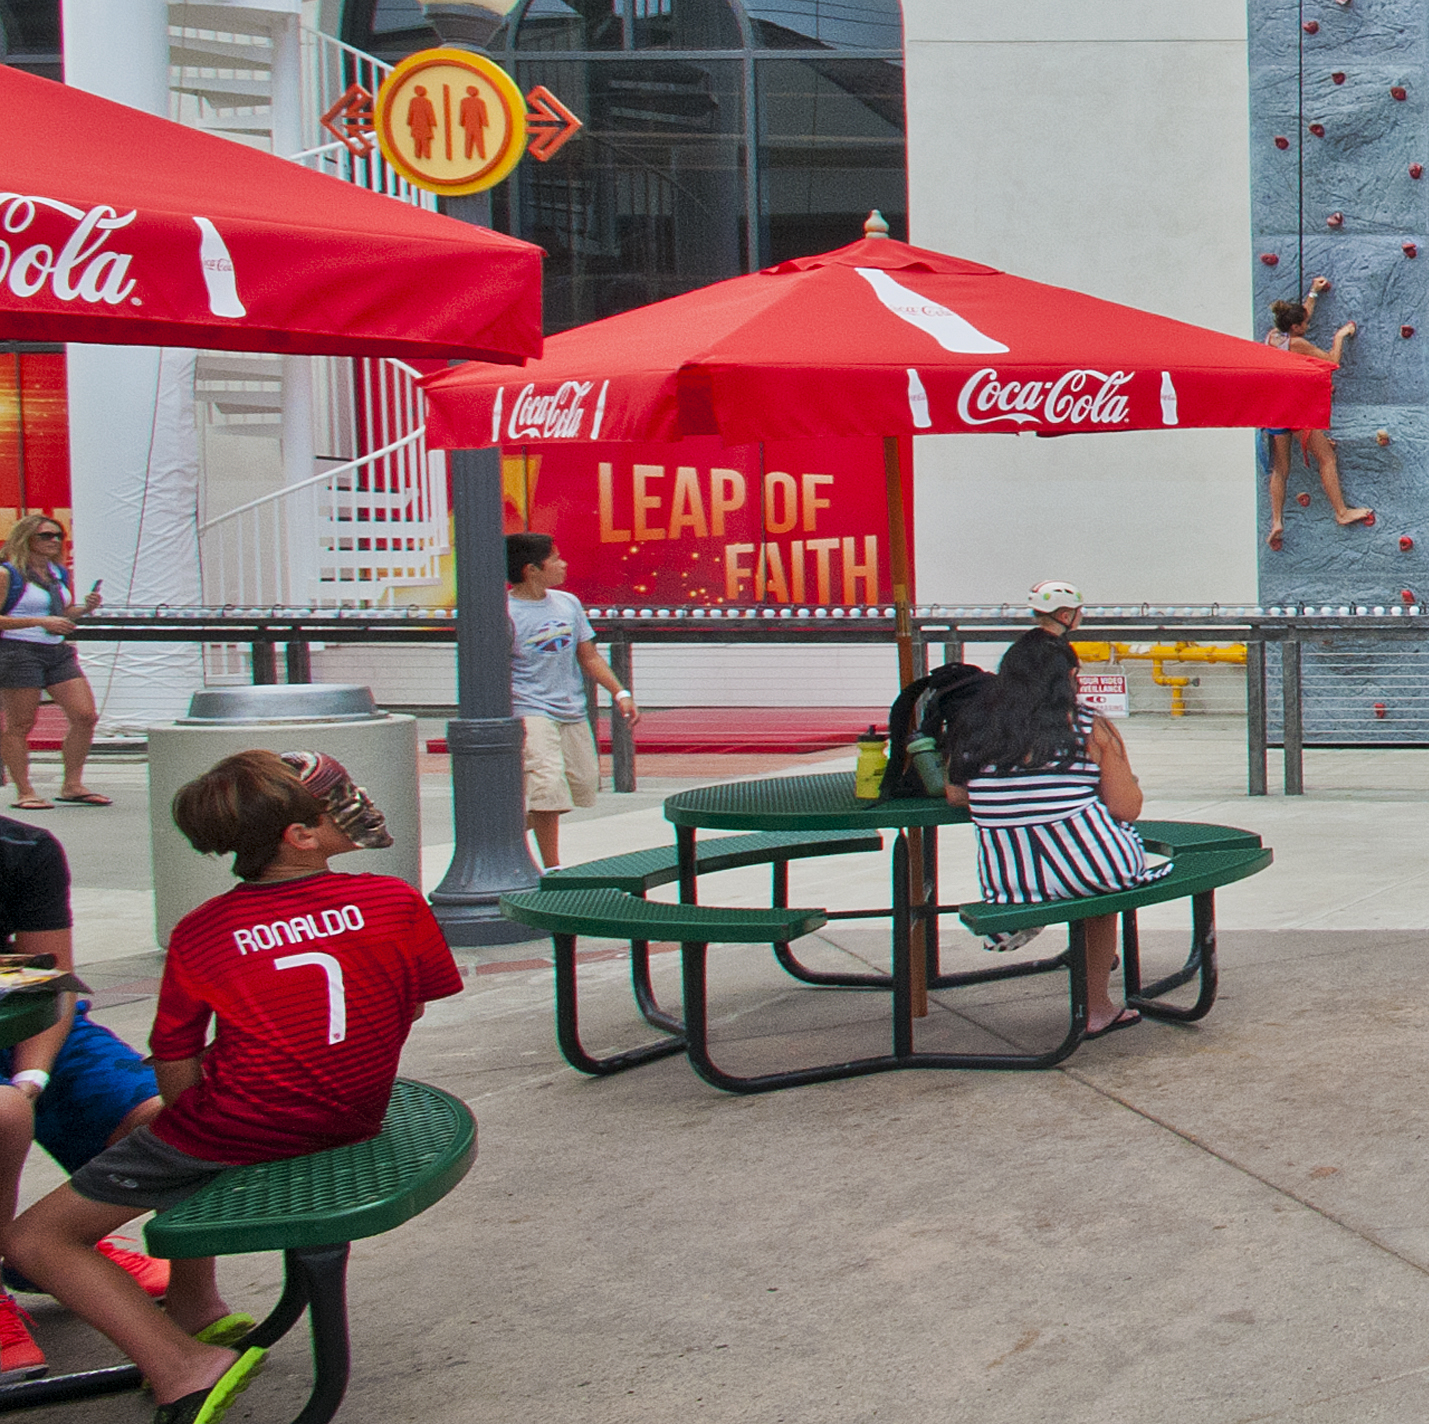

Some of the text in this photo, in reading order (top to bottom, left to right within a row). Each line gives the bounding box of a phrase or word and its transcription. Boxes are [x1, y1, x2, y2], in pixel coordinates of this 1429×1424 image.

[507, 380, 595, 440] Coca-Cola
[957, 368, 1135, 425] Coca-Cola
[598, 461, 834, 543] LEAP OF
[724, 534, 879, 606] FAITH
[233, 904, 365, 956] RONALDO
[273, 951, 347, 1046] 7
